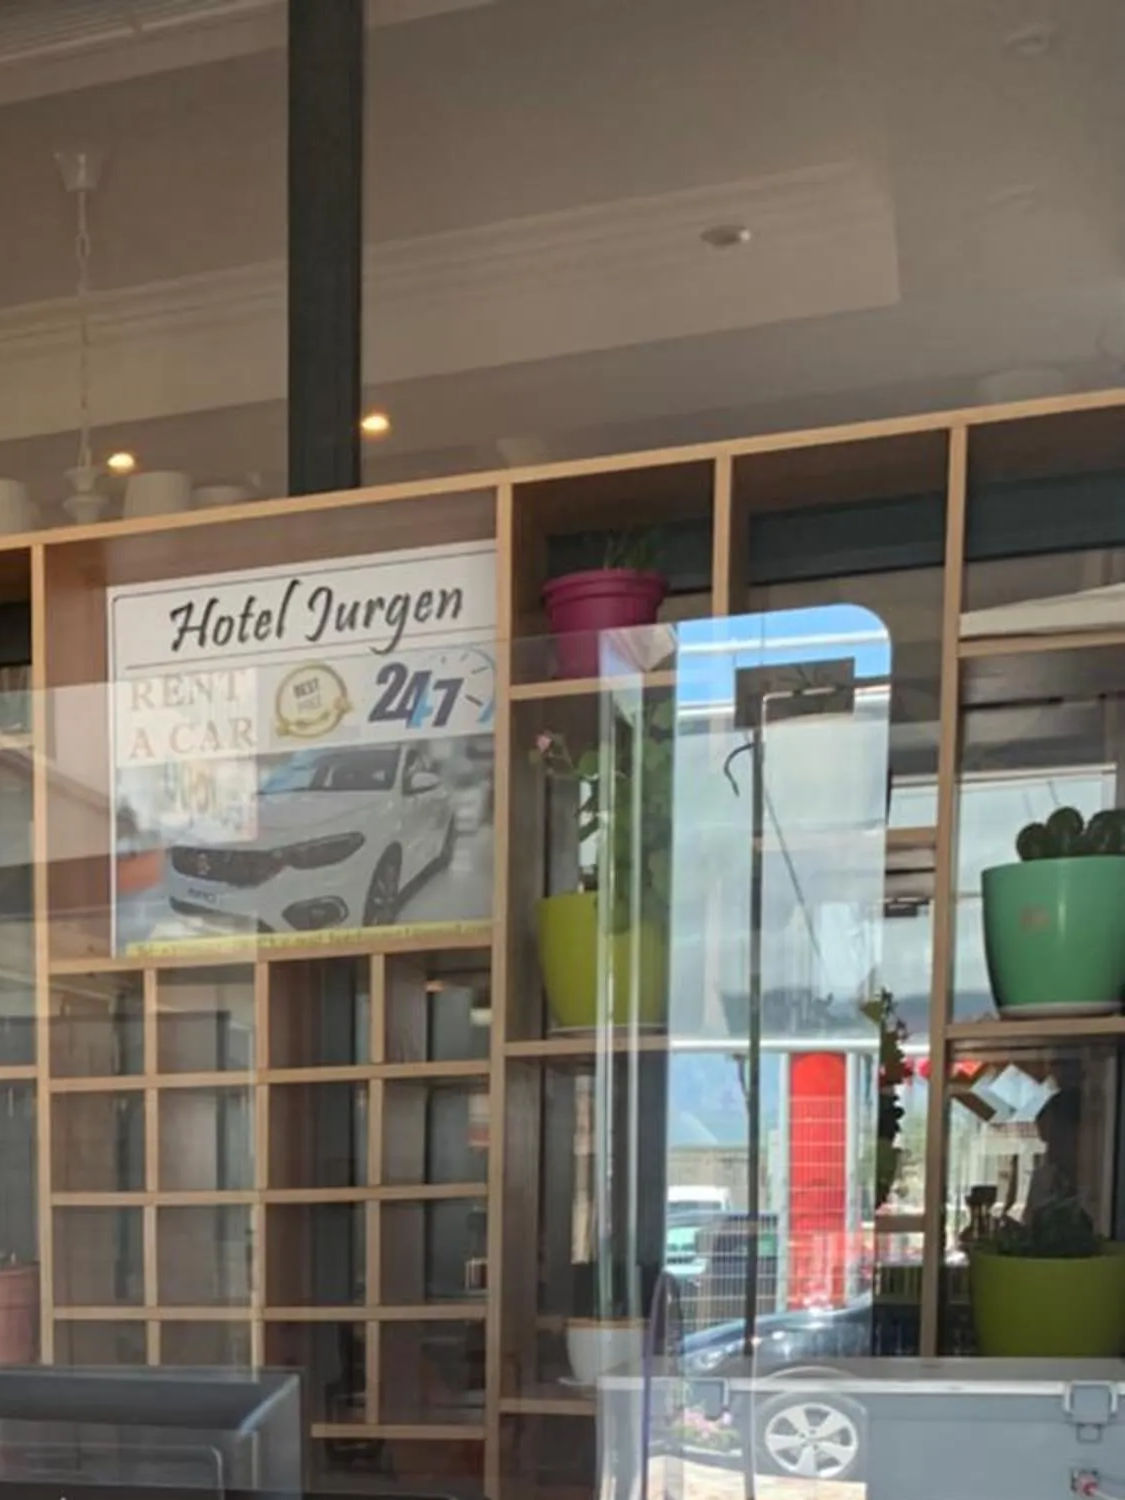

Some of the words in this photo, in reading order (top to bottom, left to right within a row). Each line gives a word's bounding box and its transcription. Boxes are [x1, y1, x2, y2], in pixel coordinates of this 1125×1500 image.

[170, 579, 300, 652] Hotel
[305, 586, 463, 656] Jurgen
[130, 671, 248, 711] RENT
[129, 727, 156, 759] A
[169, 716, 257, 754] CAR
